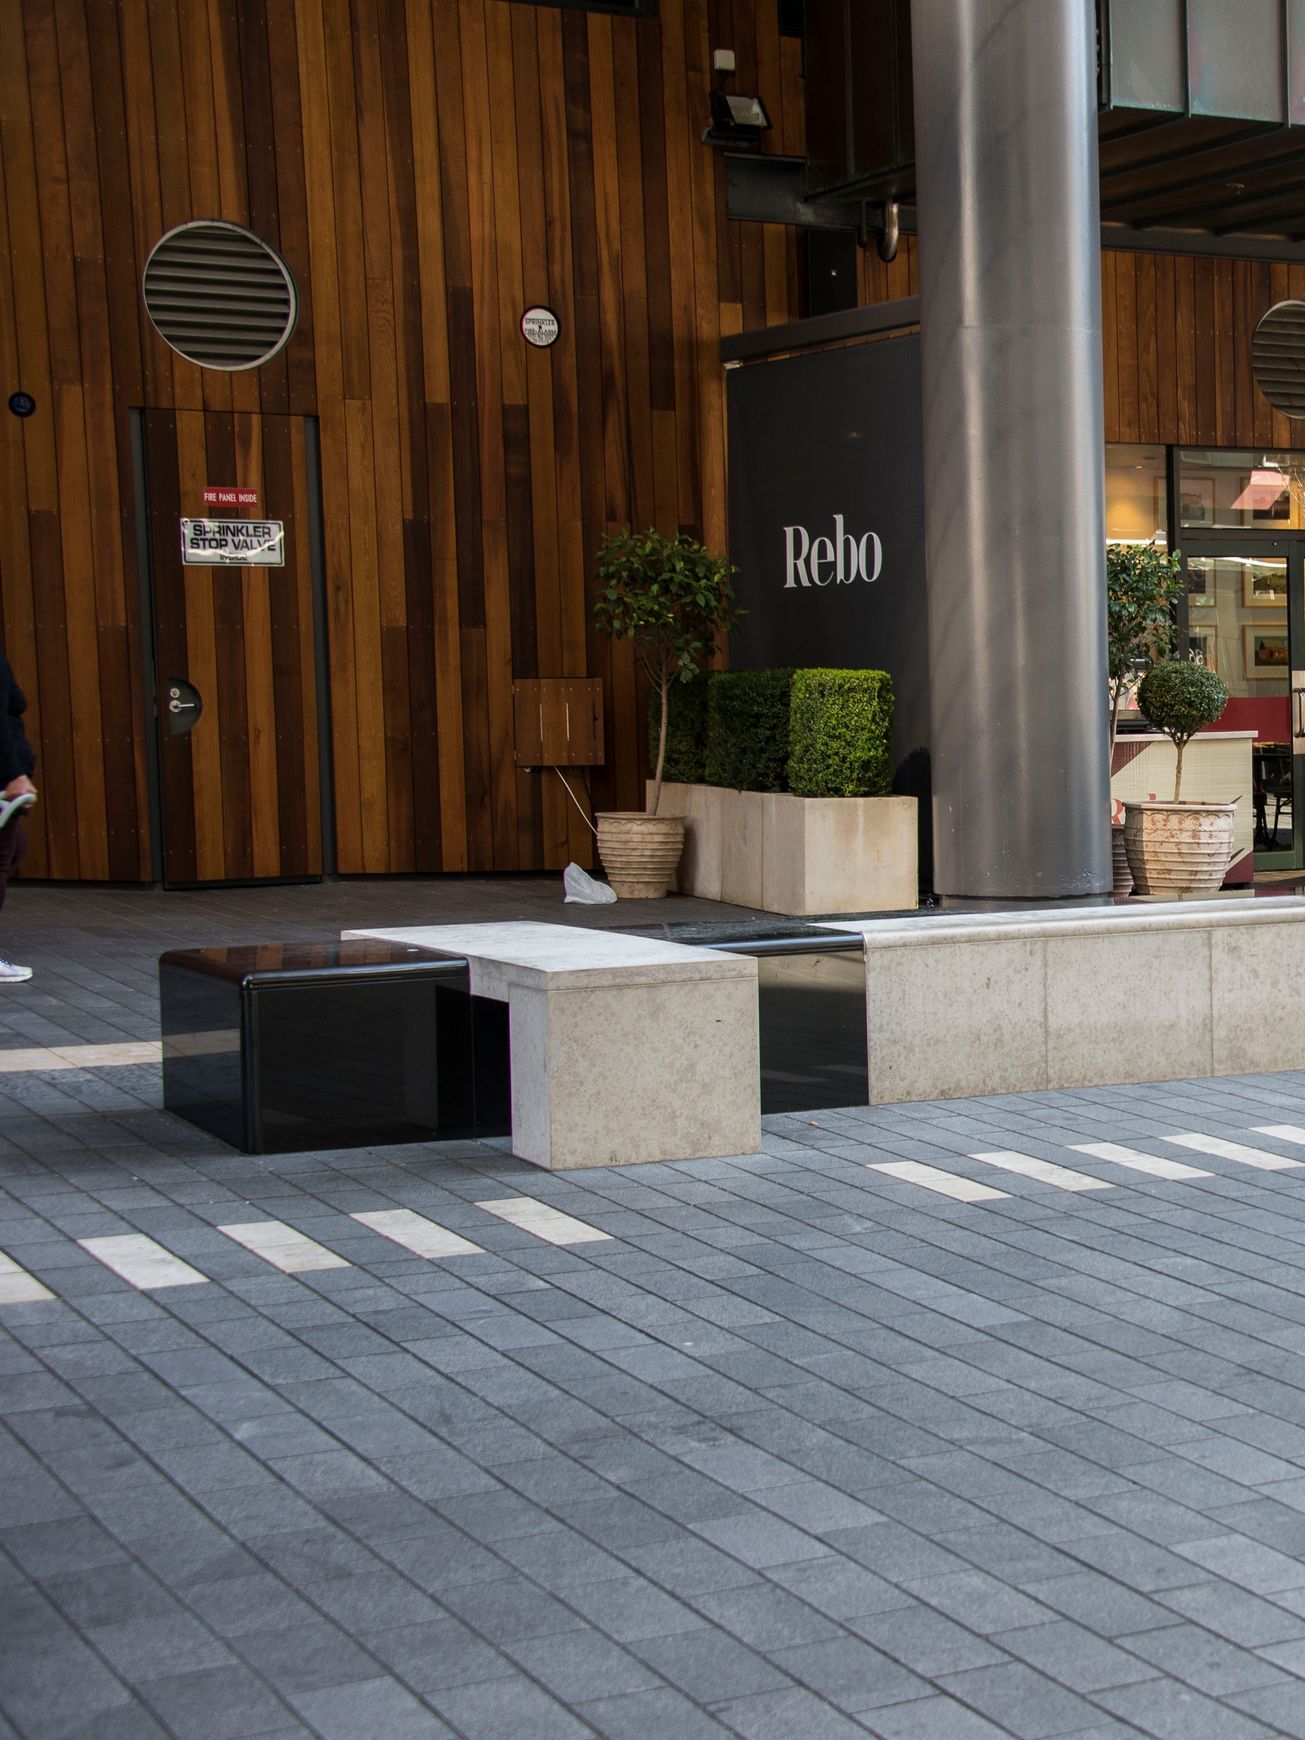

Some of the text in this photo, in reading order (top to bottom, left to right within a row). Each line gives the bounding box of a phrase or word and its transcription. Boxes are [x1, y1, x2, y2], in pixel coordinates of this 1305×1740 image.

[204, 492, 257, 503] FIRE PANEL INSIDE
[193, 525, 271, 538] SPRINKLER
[190, 538, 228, 550] STOP
[783, 514, 883, 588] Rebo
